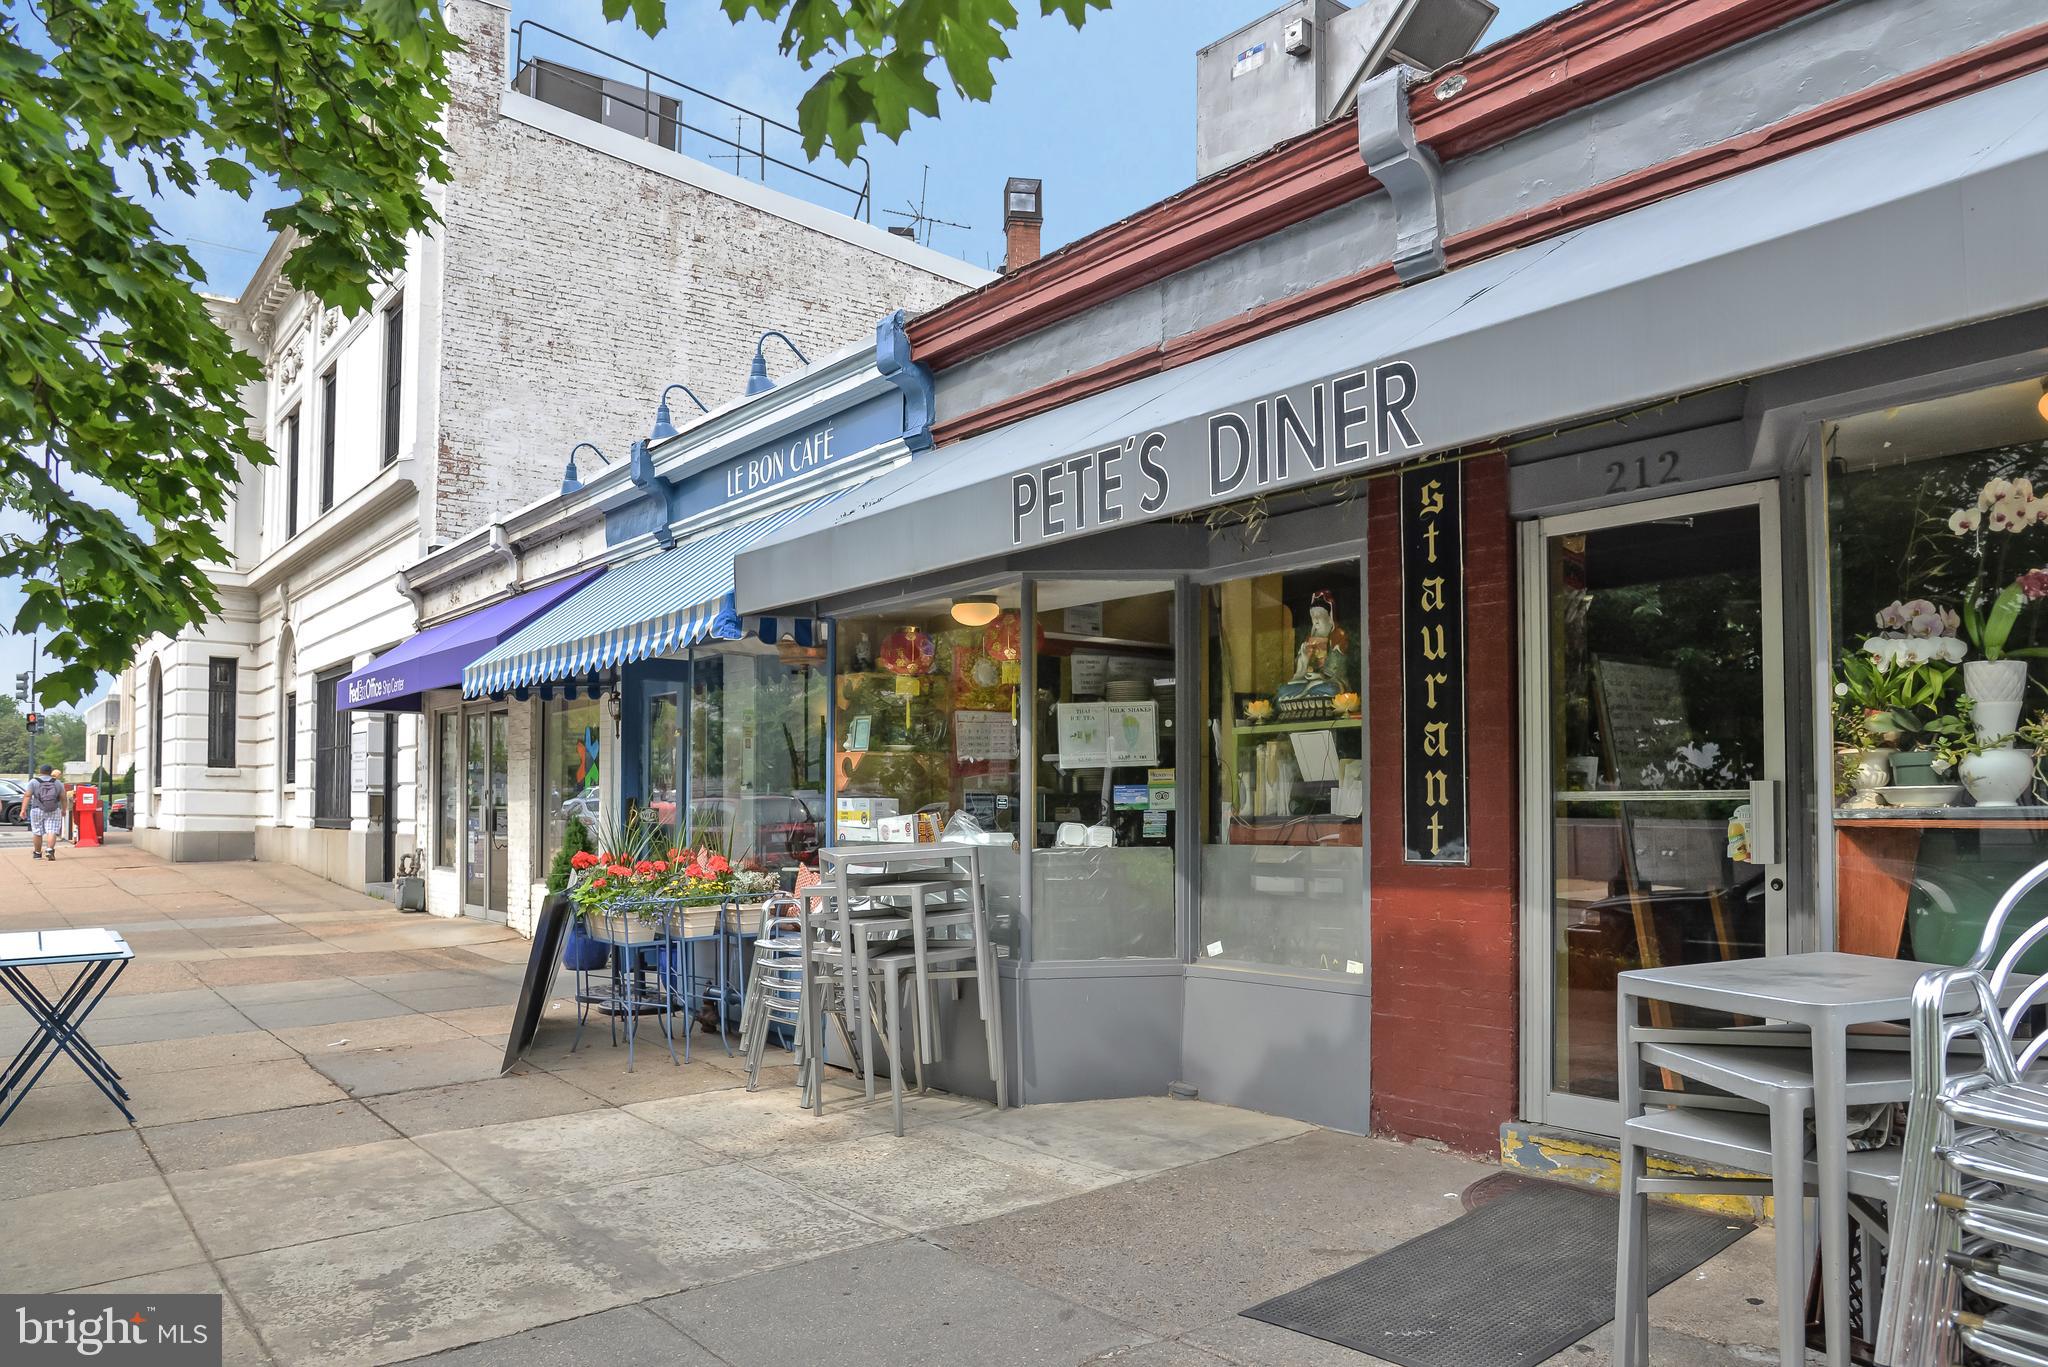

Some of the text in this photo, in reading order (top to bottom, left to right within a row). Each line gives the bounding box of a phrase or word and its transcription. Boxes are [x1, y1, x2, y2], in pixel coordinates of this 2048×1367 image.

[727, 420, 834, 498] LE BON CAFÉ
[1012, 360, 1423, 544] PETE'S DINER
[1606, 450, 1681, 494] 212
[1419, 479, 1449, 857] staurant
